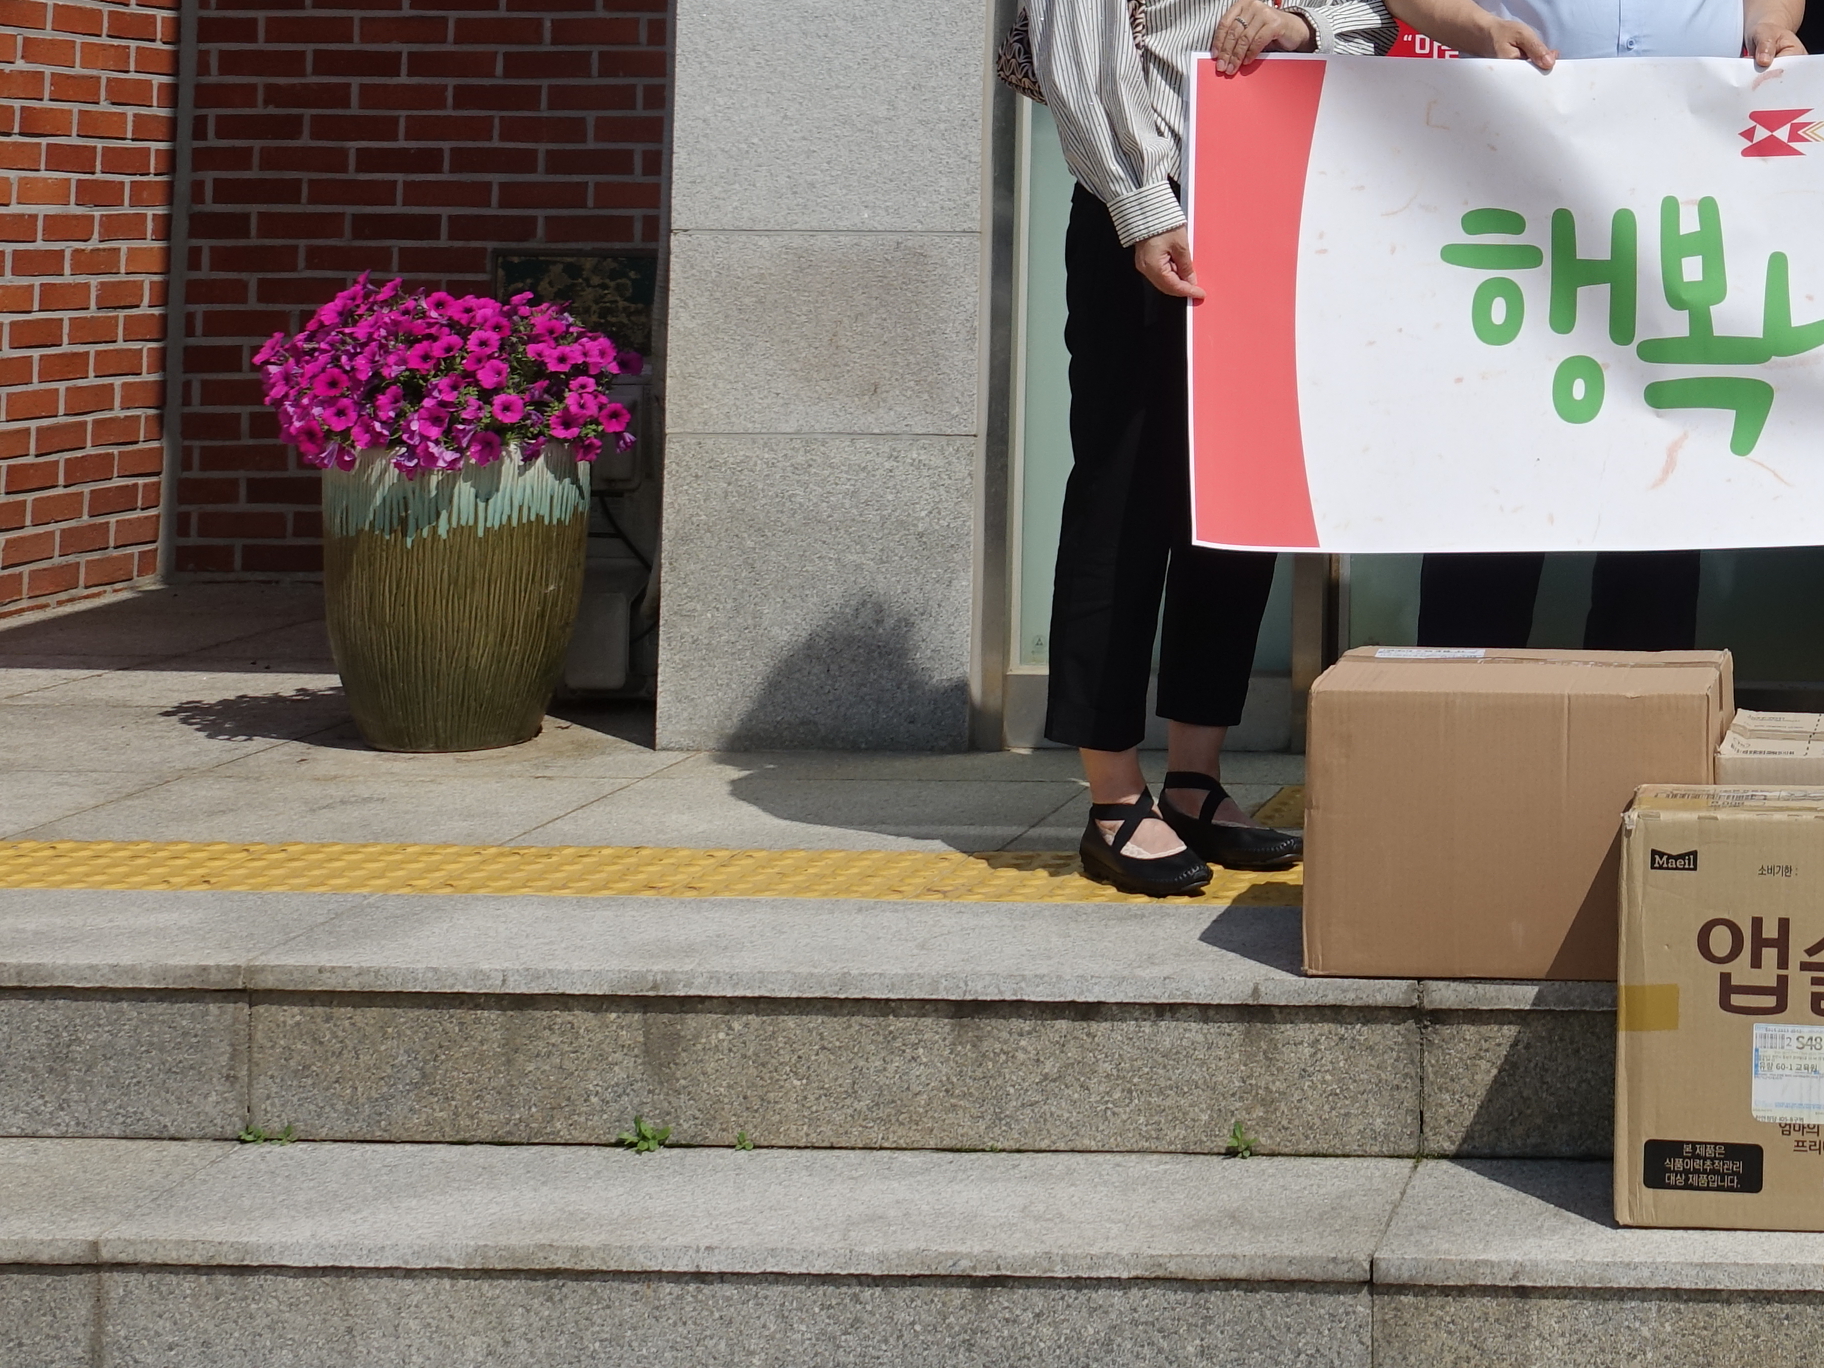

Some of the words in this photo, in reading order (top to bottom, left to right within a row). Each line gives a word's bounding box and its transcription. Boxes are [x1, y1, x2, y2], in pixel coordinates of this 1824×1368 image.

[1653, 854, 1695, 869] Maeil
[1758, 864, 1793, 877] 소비기한
[1796, 1035, 1823, 1051] S48
[1683, 1143, 1692, 1156] 본
[1695, 1144, 1725, 1157] 제품은
[1664, 1158, 1743, 1174] 식품이력추적관리
[1665, 1173, 1685, 1186] 대상
[1688, 1174, 1741, 1188] 제품입니다.
